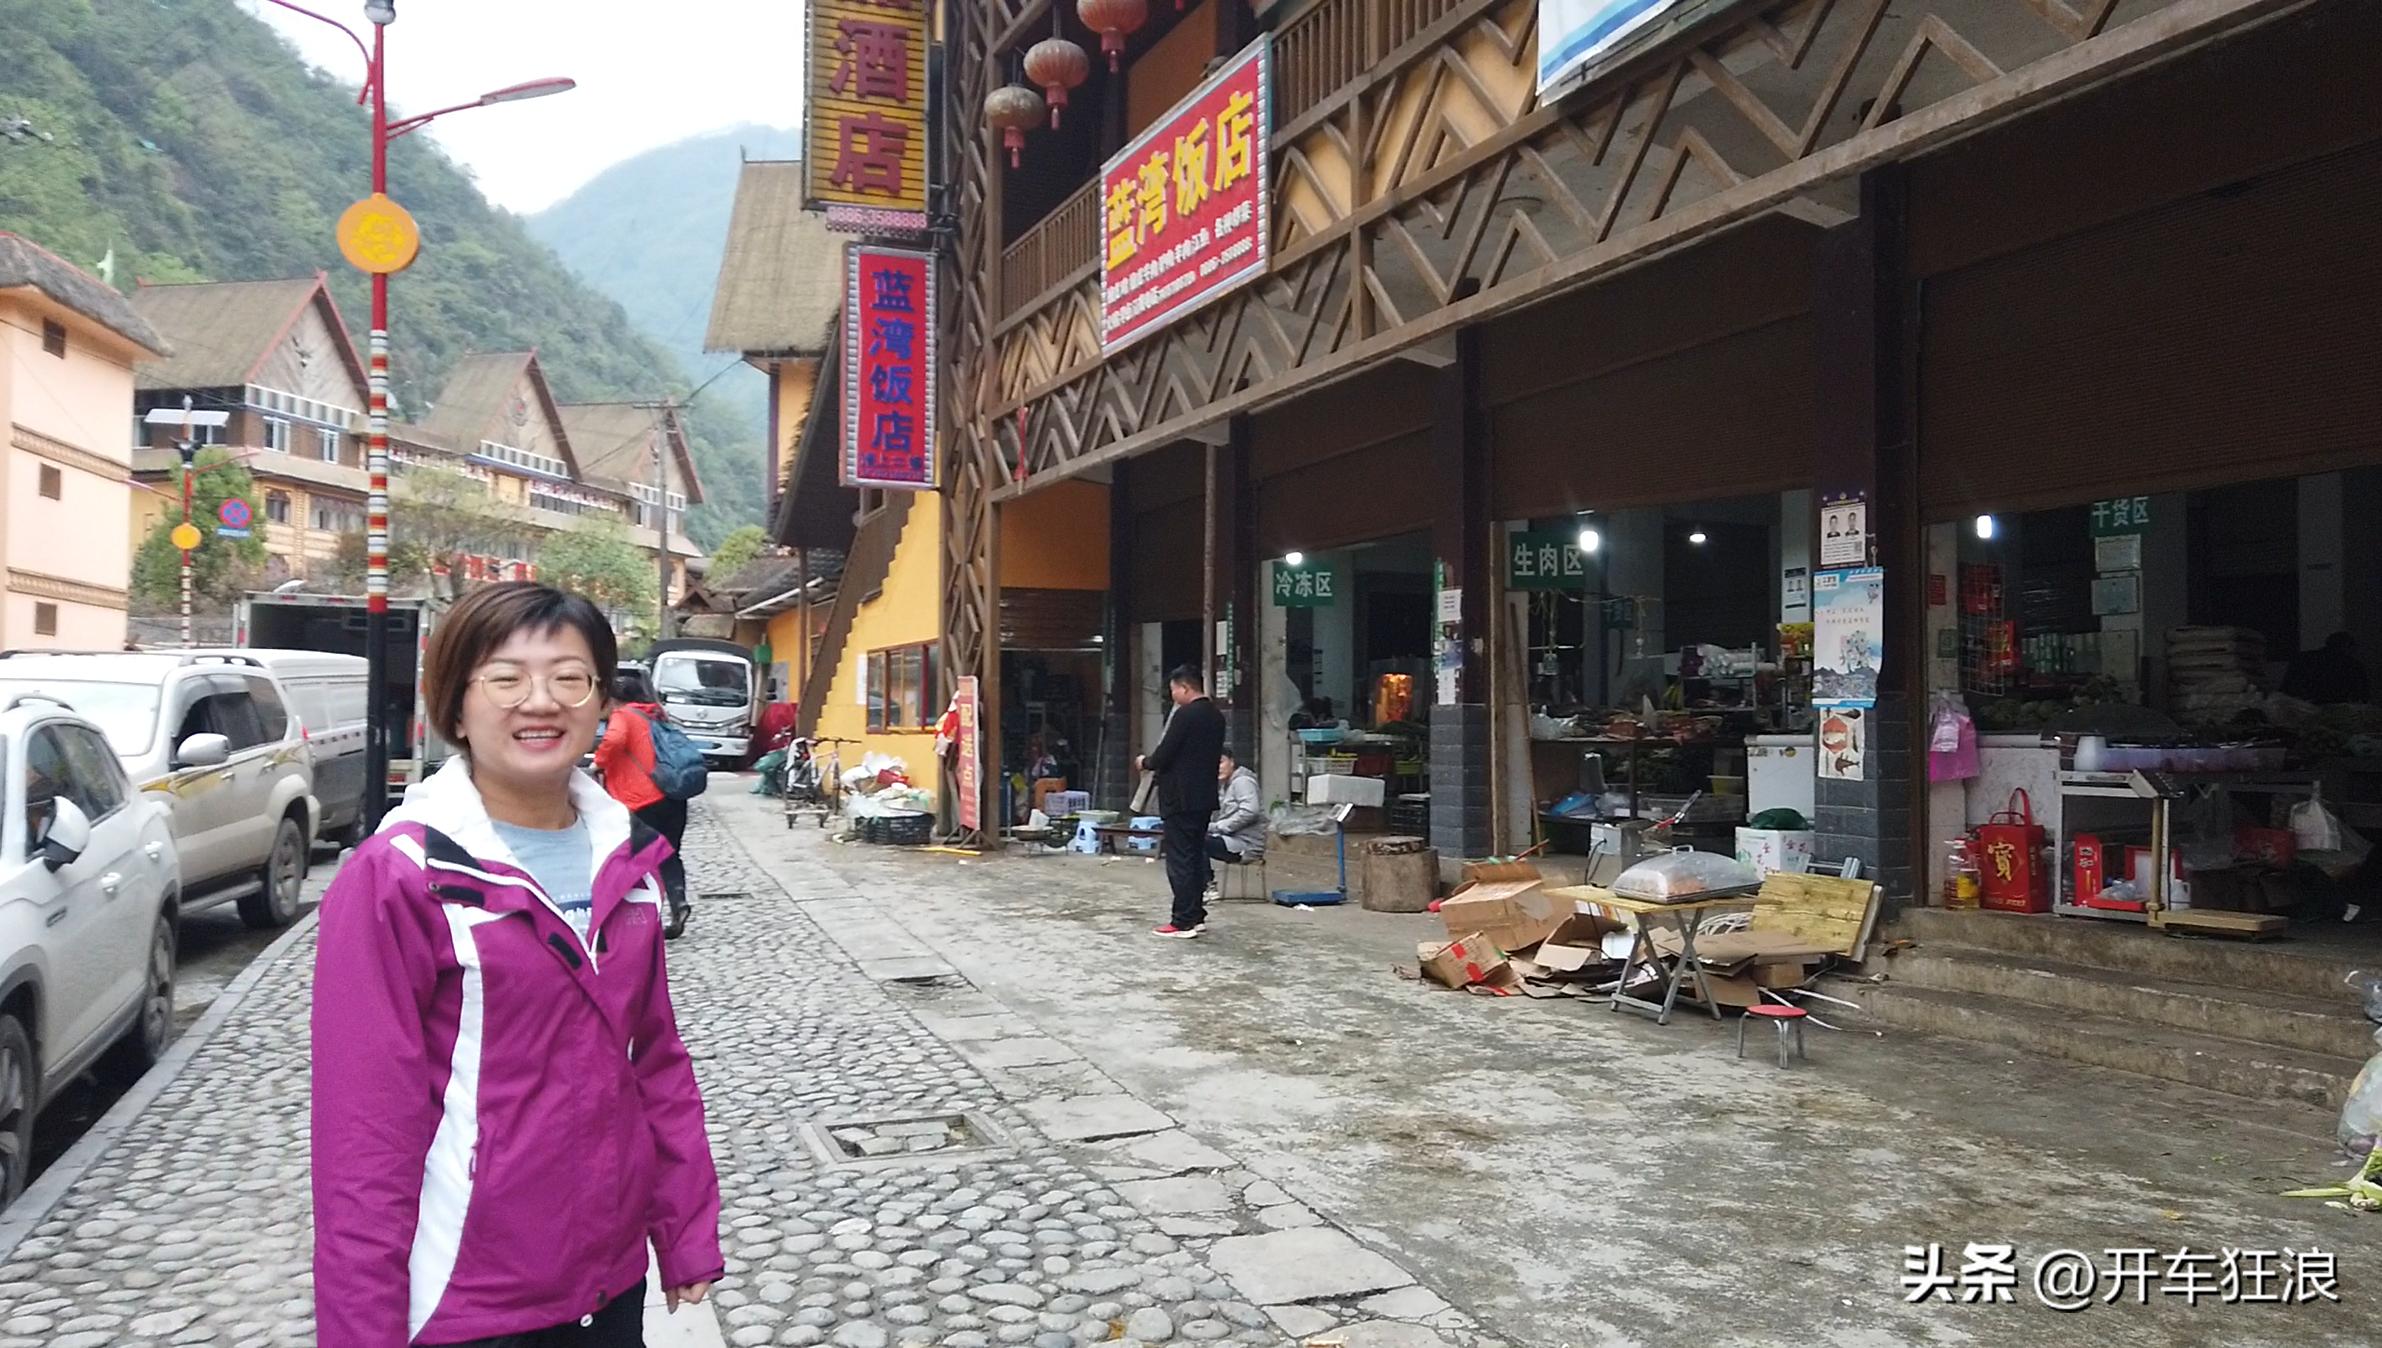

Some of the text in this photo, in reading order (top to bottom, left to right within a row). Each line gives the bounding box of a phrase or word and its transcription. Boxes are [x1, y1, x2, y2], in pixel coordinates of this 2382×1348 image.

[829, 0, 911, 196] 酒店
[1106, 90, 1255, 271] 蓝湾饭店
[868, 268, 916, 453] 蓝湾饭店
[1514, 543, 1584, 577] 生肉区
[2092, 496, 2150, 529] 干货区
[1275, 570, 1334, 598] 冷冻区
